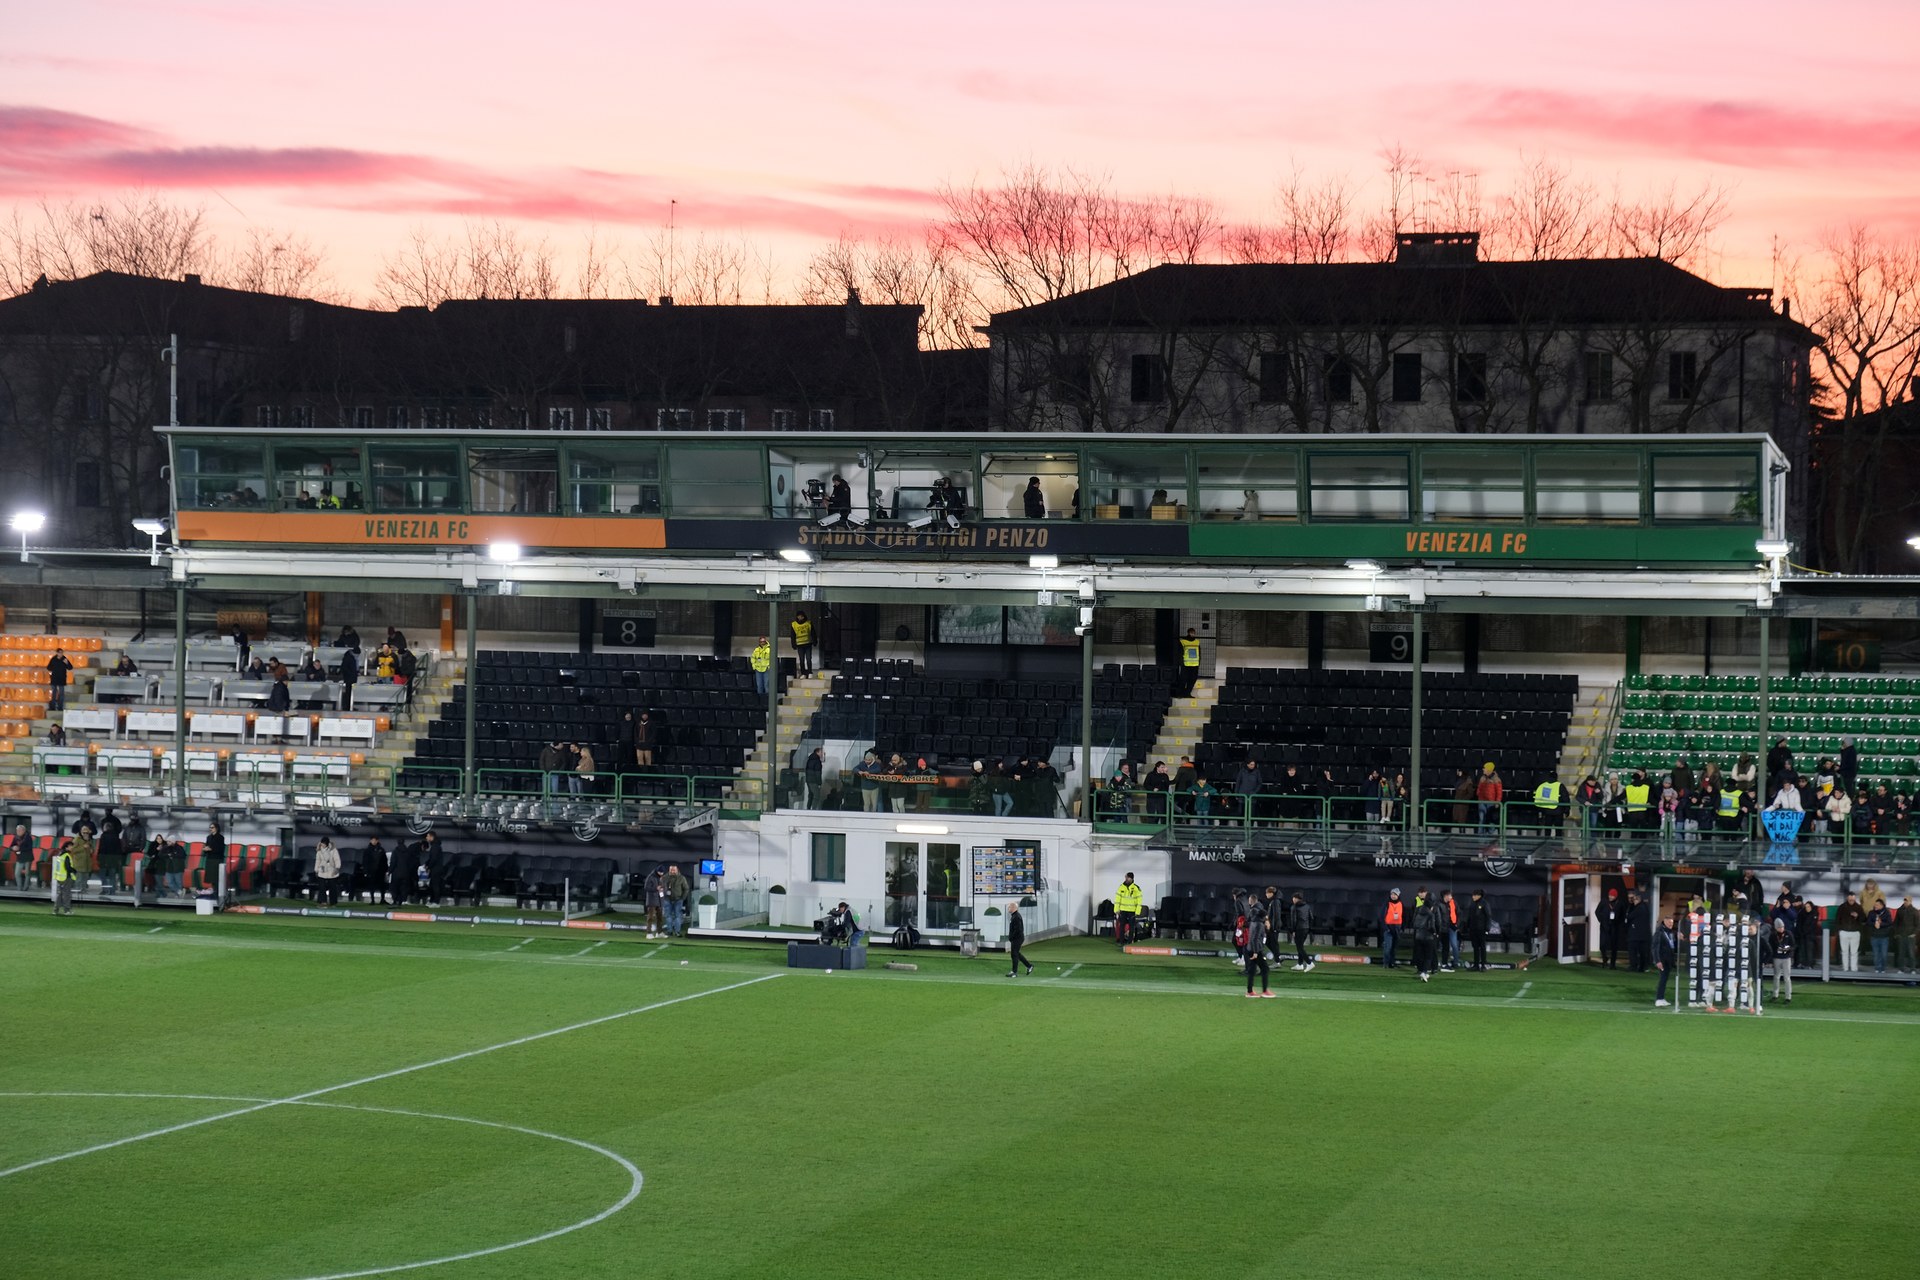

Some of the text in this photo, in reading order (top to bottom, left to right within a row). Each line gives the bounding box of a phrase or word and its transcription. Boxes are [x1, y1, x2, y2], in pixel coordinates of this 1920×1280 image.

[365, 520, 469, 540] VENEZIA FC
[798, 525, 1049, 548] STADIO PIER LUIGI PENZO
[1406, 532, 1527, 554] VENEZIA FC
[217, 612, 266, 625] STAMPA
[621, 620, 637, 644] 8
[1391, 635, 1409, 660] 9
[1836, 644, 1866, 669] 10
[901, 775, 936, 783] AMORE
[311, 816, 362, 827] MANAGER
[1762, 811, 1804, 821] ESPOSITO
[476, 822, 528, 834] MANAGER
[1768, 820, 1793, 831] MI DAI
[1188, 851, 1246, 863] MANAGER
[1375, 857, 1434, 869] MANAGER
